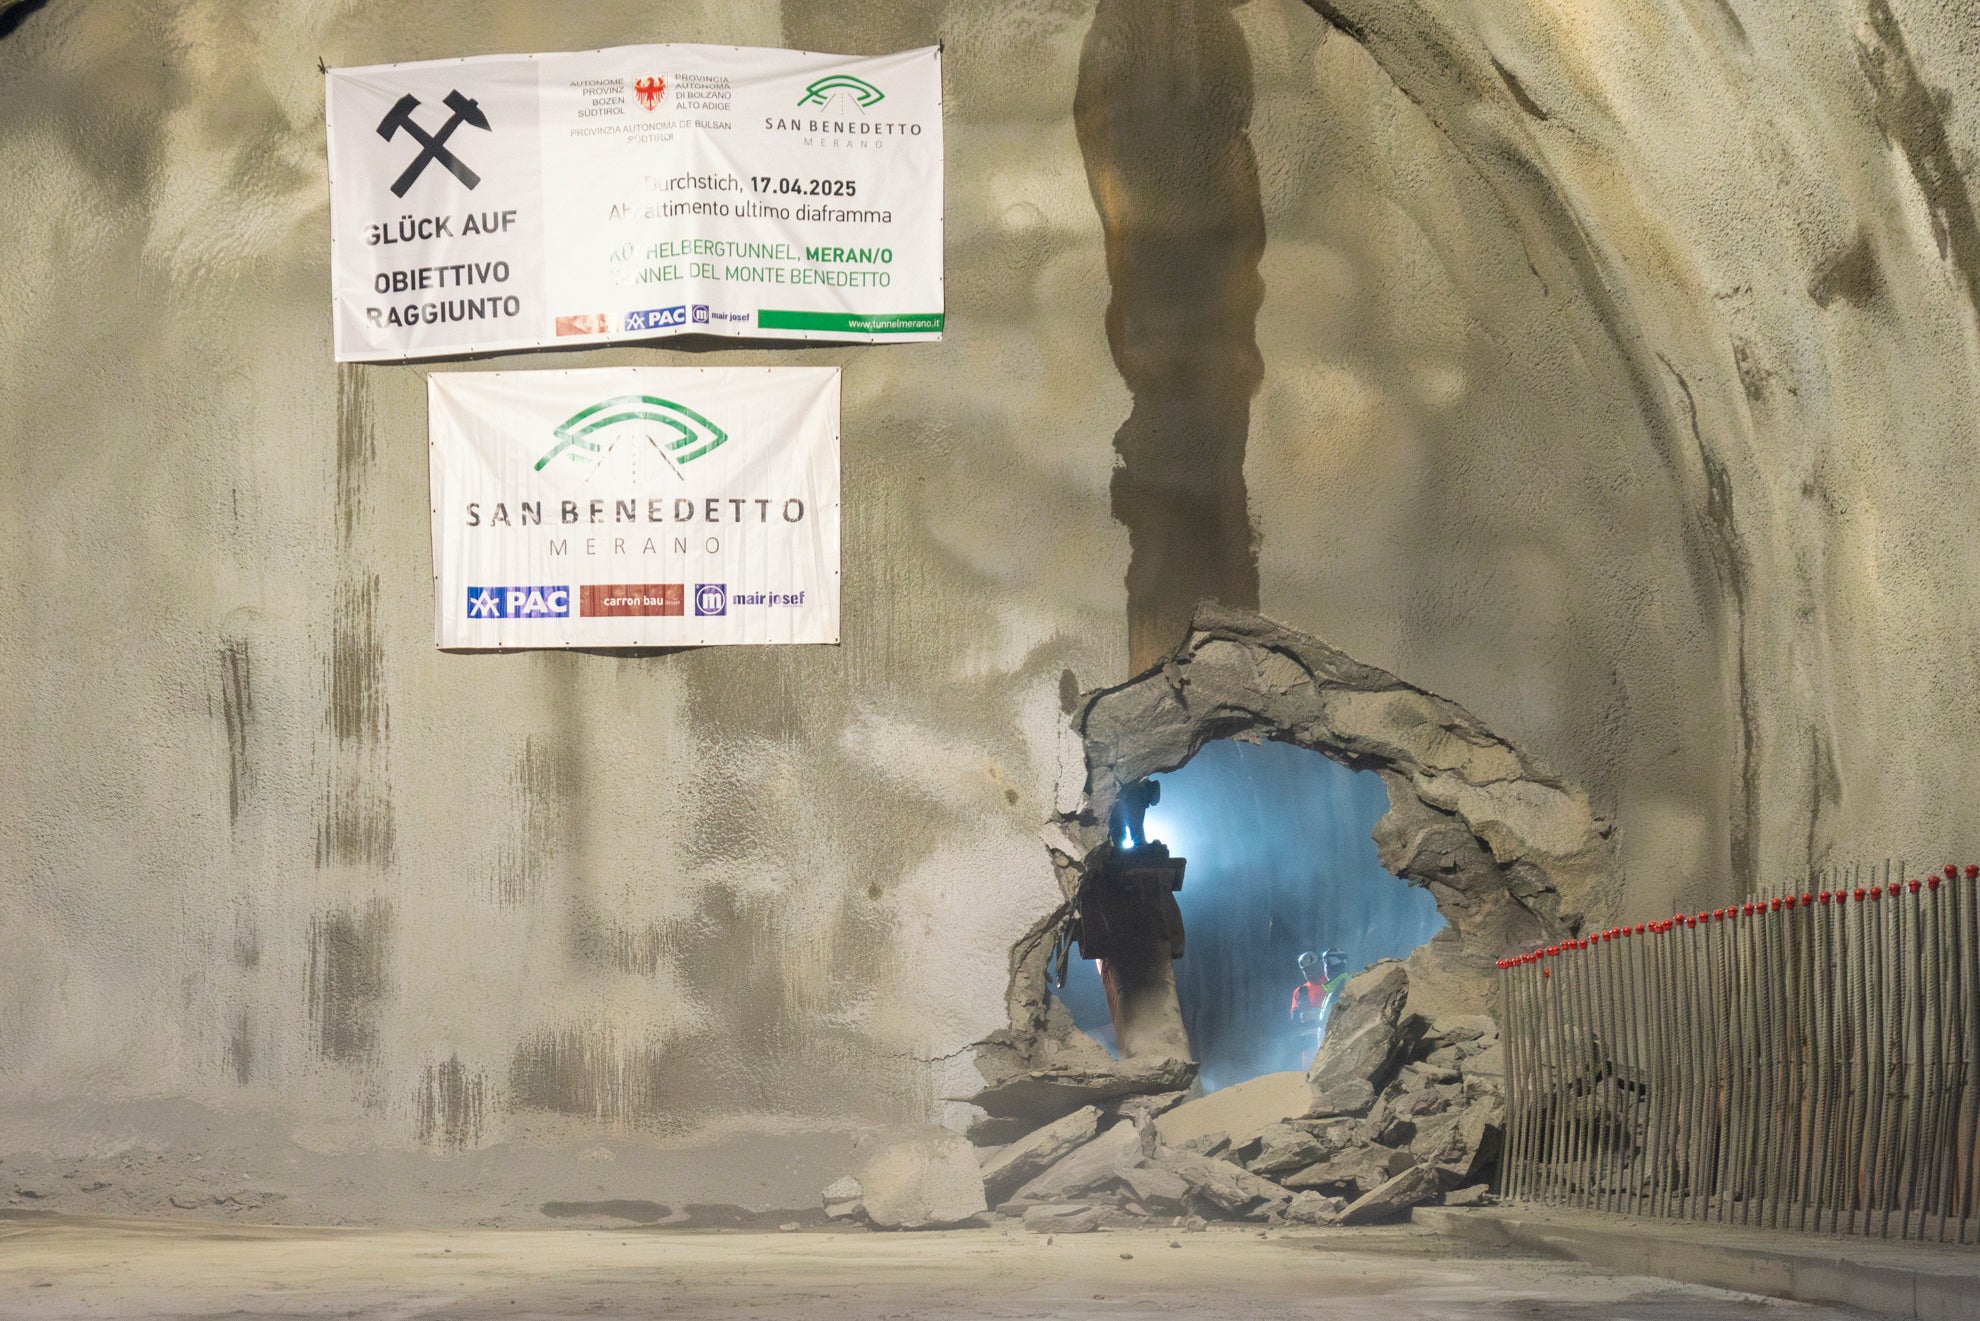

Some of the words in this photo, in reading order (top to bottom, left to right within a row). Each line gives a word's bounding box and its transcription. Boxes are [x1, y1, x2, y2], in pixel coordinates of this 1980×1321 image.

[570, 78, 624, 87] AUTONOME
[675, 73, 729, 83] PROVINCIA
[582, 86, 625, 96] PROVINZ
[676, 91, 685, 99] DI
[687, 91, 732, 100] BOLZANO
[592, 97, 625, 106] BOZEN
[676, 101, 700, 110] ALTO
[702, 102, 731, 111] ADIGE
[578, 107, 626, 118] SÜDTIROL
[570, 126, 622, 137] PROVINZIA
[622, 121, 677, 133] AUTONOMA
[679, 119, 693, 128] DE
[695, 119, 731, 130] BULSAN
[765, 117, 801, 131] SAN
[809, 119, 922, 136] BENEDETTO
[803, 137, 883, 149] MERANO
[751, 176, 856, 197] 17.04.2025
[609, 200, 729, 221] Aattimento
[735, 200, 790, 220] ultimo
[796, 203, 892, 223] diaframma
[364, 214, 454, 246] GLÜCK
[462, 210, 517, 236] AUF
[610, 239, 801, 262] KÜHELBERGTUNNEL,
[805, 246, 893, 264] MERAN/O
[374, 260, 510, 294] OBIETTIVO
[610, 264, 683, 286] NNEL
[689, 262, 721, 280] DEL
[725, 265, 785, 284] MONTE
[790, 268, 891, 287] BENEDETTO
[366, 295, 520, 328] RAGGIUNTO
[649, 308, 686, 327] PAC
[711, 312, 728, 320] mair
[729, 312, 750, 322] josef
[849, 318, 940, 329] www.tunnelmerano.it
[466, 501, 542, 527] SAN
[561, 498, 805, 524] BENEDETTO
[549, 537, 720, 556] MERANO
[506, 590, 568, 614] PAC
[603, 597, 640, 607] carron
[643, 596, 663, 606] bau
[733, 591, 766, 605] mair
[768, 591, 805, 608] josef
